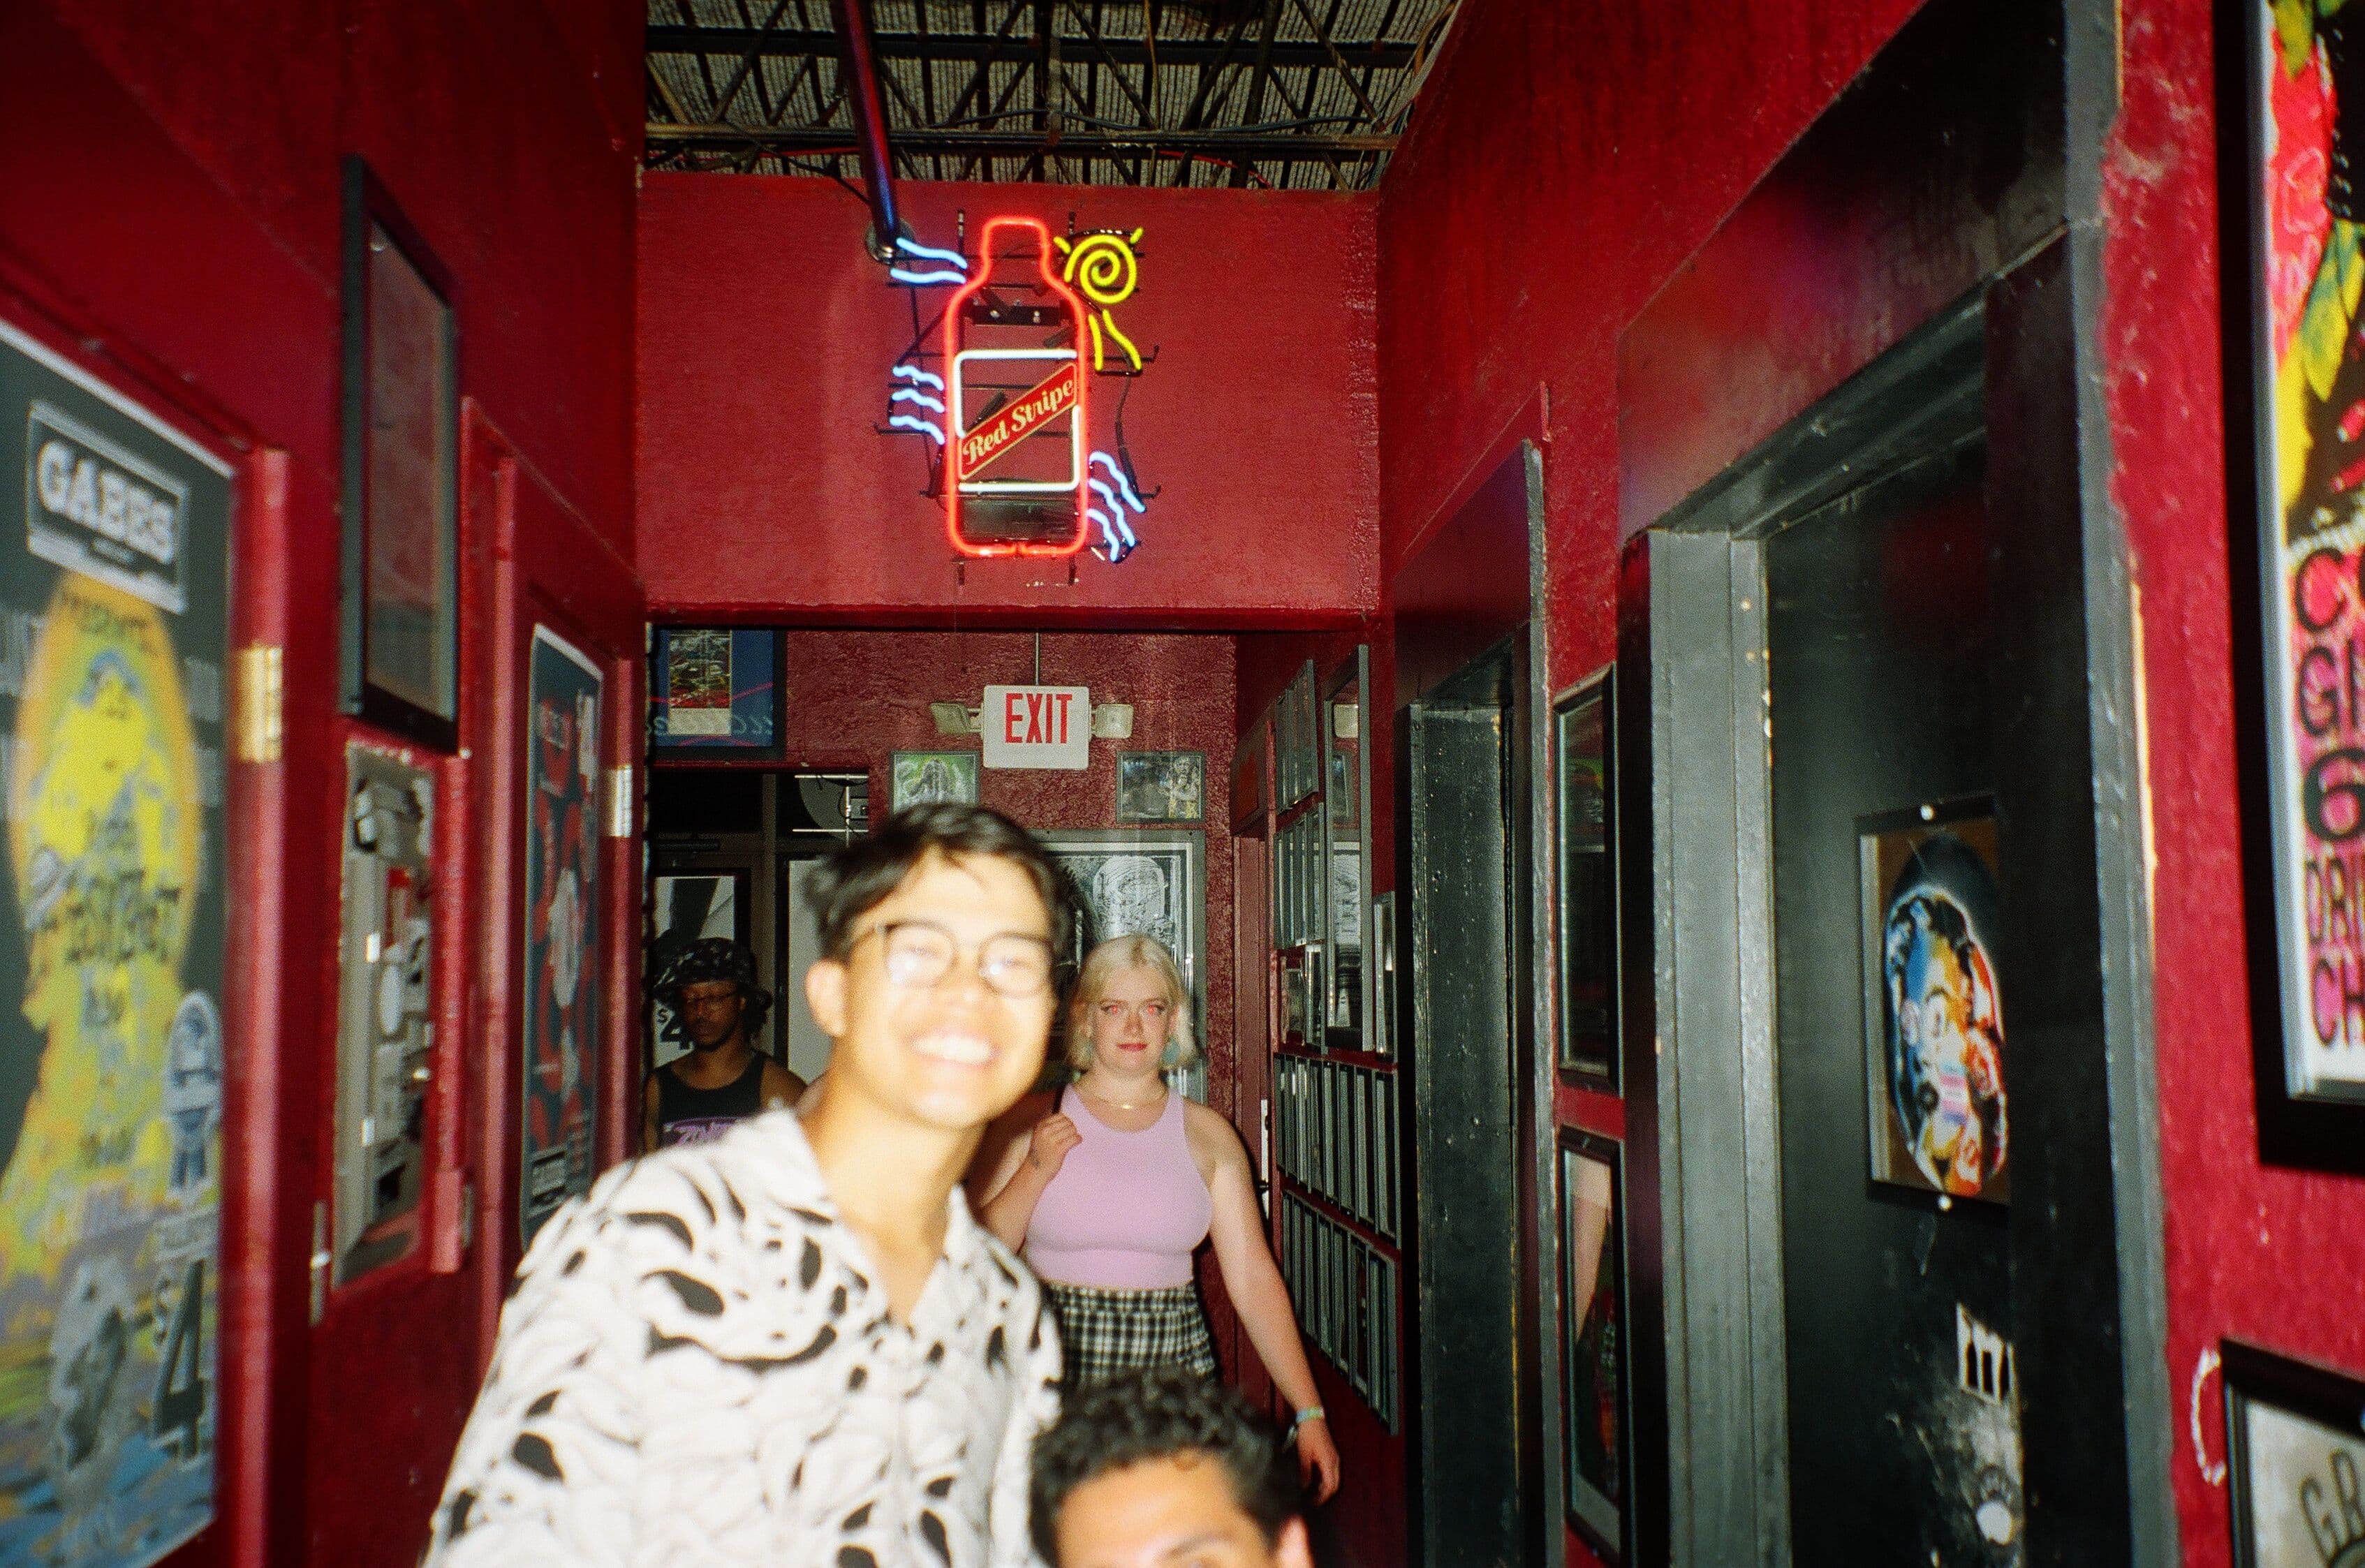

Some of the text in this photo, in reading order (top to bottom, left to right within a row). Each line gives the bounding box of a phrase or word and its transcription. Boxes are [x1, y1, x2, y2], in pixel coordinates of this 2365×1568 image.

[962, 380, 1073, 465] Red Stripe
[1005, 693, 1073, 744] EXIT
